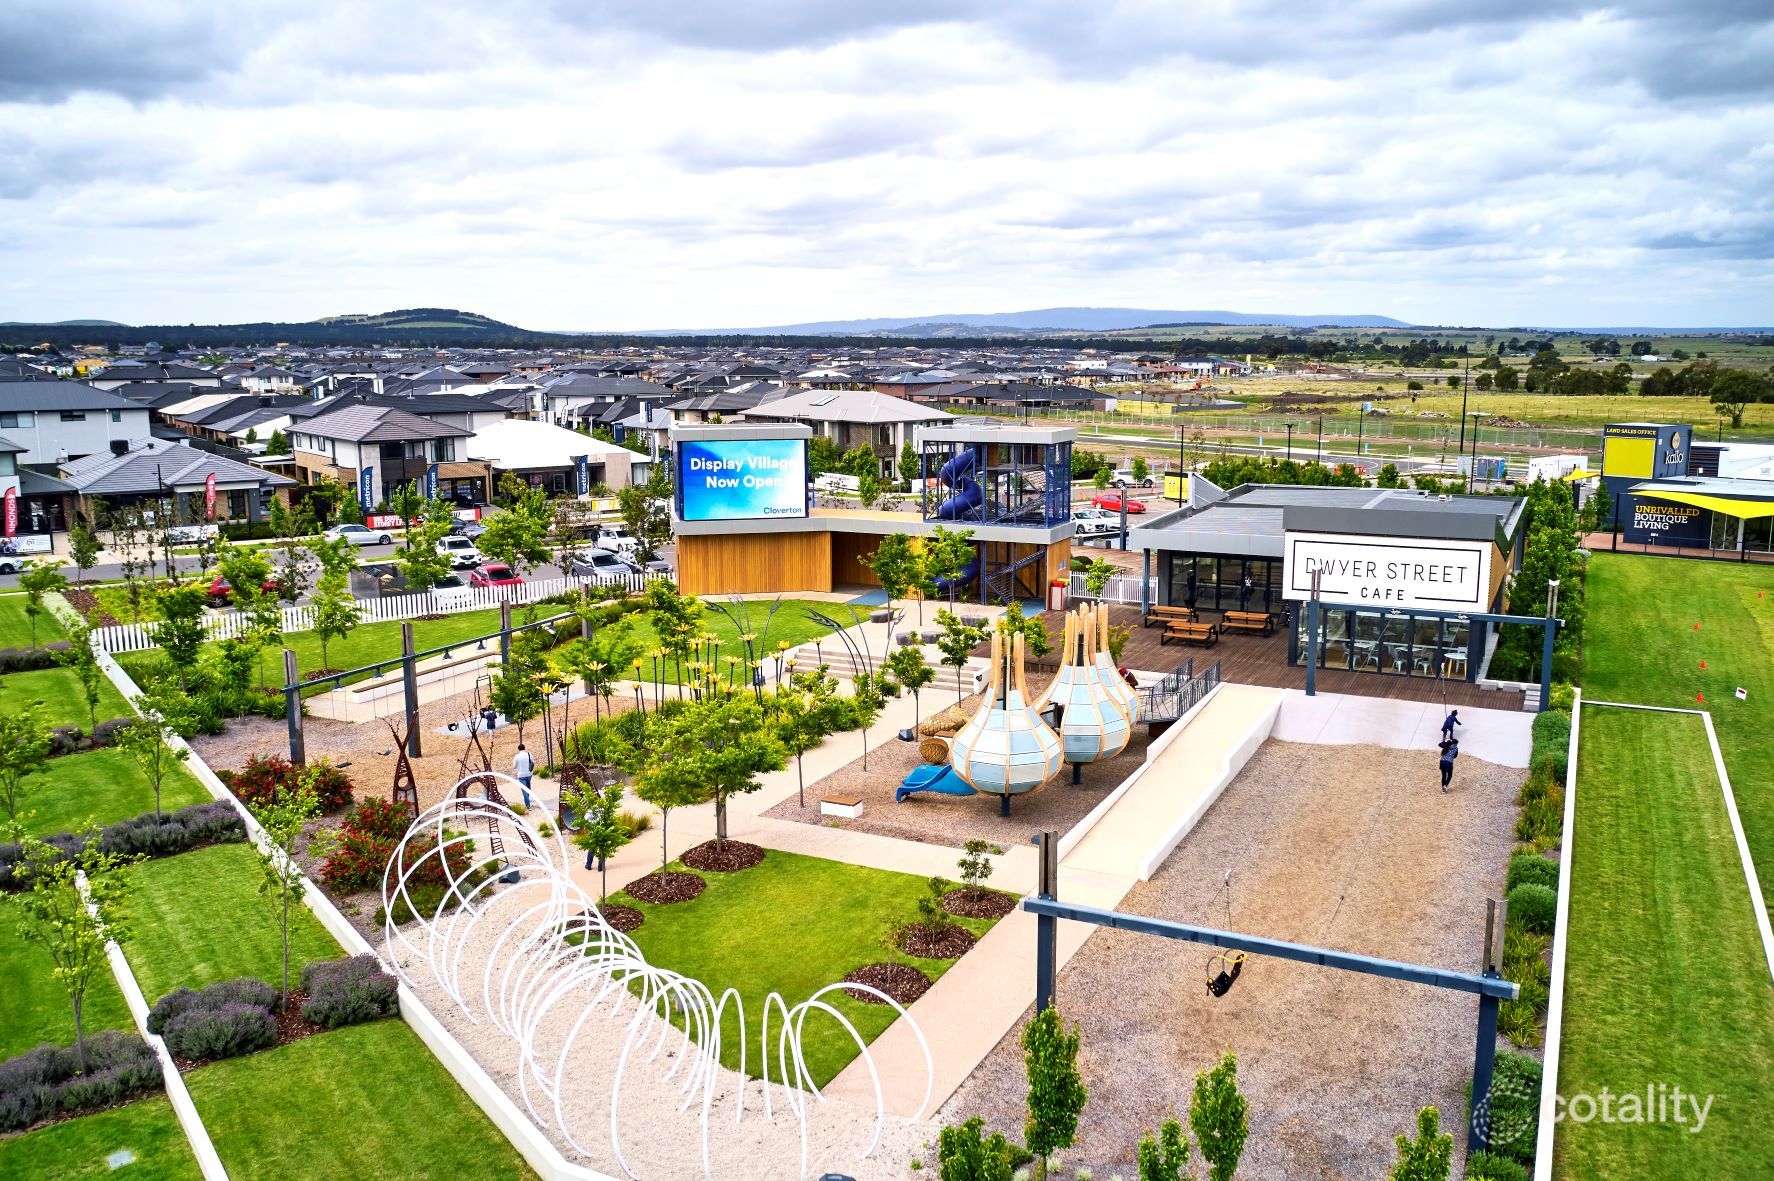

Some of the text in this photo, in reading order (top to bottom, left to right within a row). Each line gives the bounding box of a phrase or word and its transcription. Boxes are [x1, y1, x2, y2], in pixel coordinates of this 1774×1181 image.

[690, 456, 744, 472] Display
[706, 475, 784, 490] Now Open
[363, 475, 371, 508] metricon
[8, 498, 16, 533] SIMONDS
[763, 506, 802, 515] Cloverton
[1635, 505, 1700, 516] UNRIVALLED
[1634, 512, 1688, 524] BOUTIQUE
[1634, 521, 1669, 530] LIVING
[1306, 557, 1468, 583] DWYER STREET
[1361, 587, 1405, 600] CAFE
